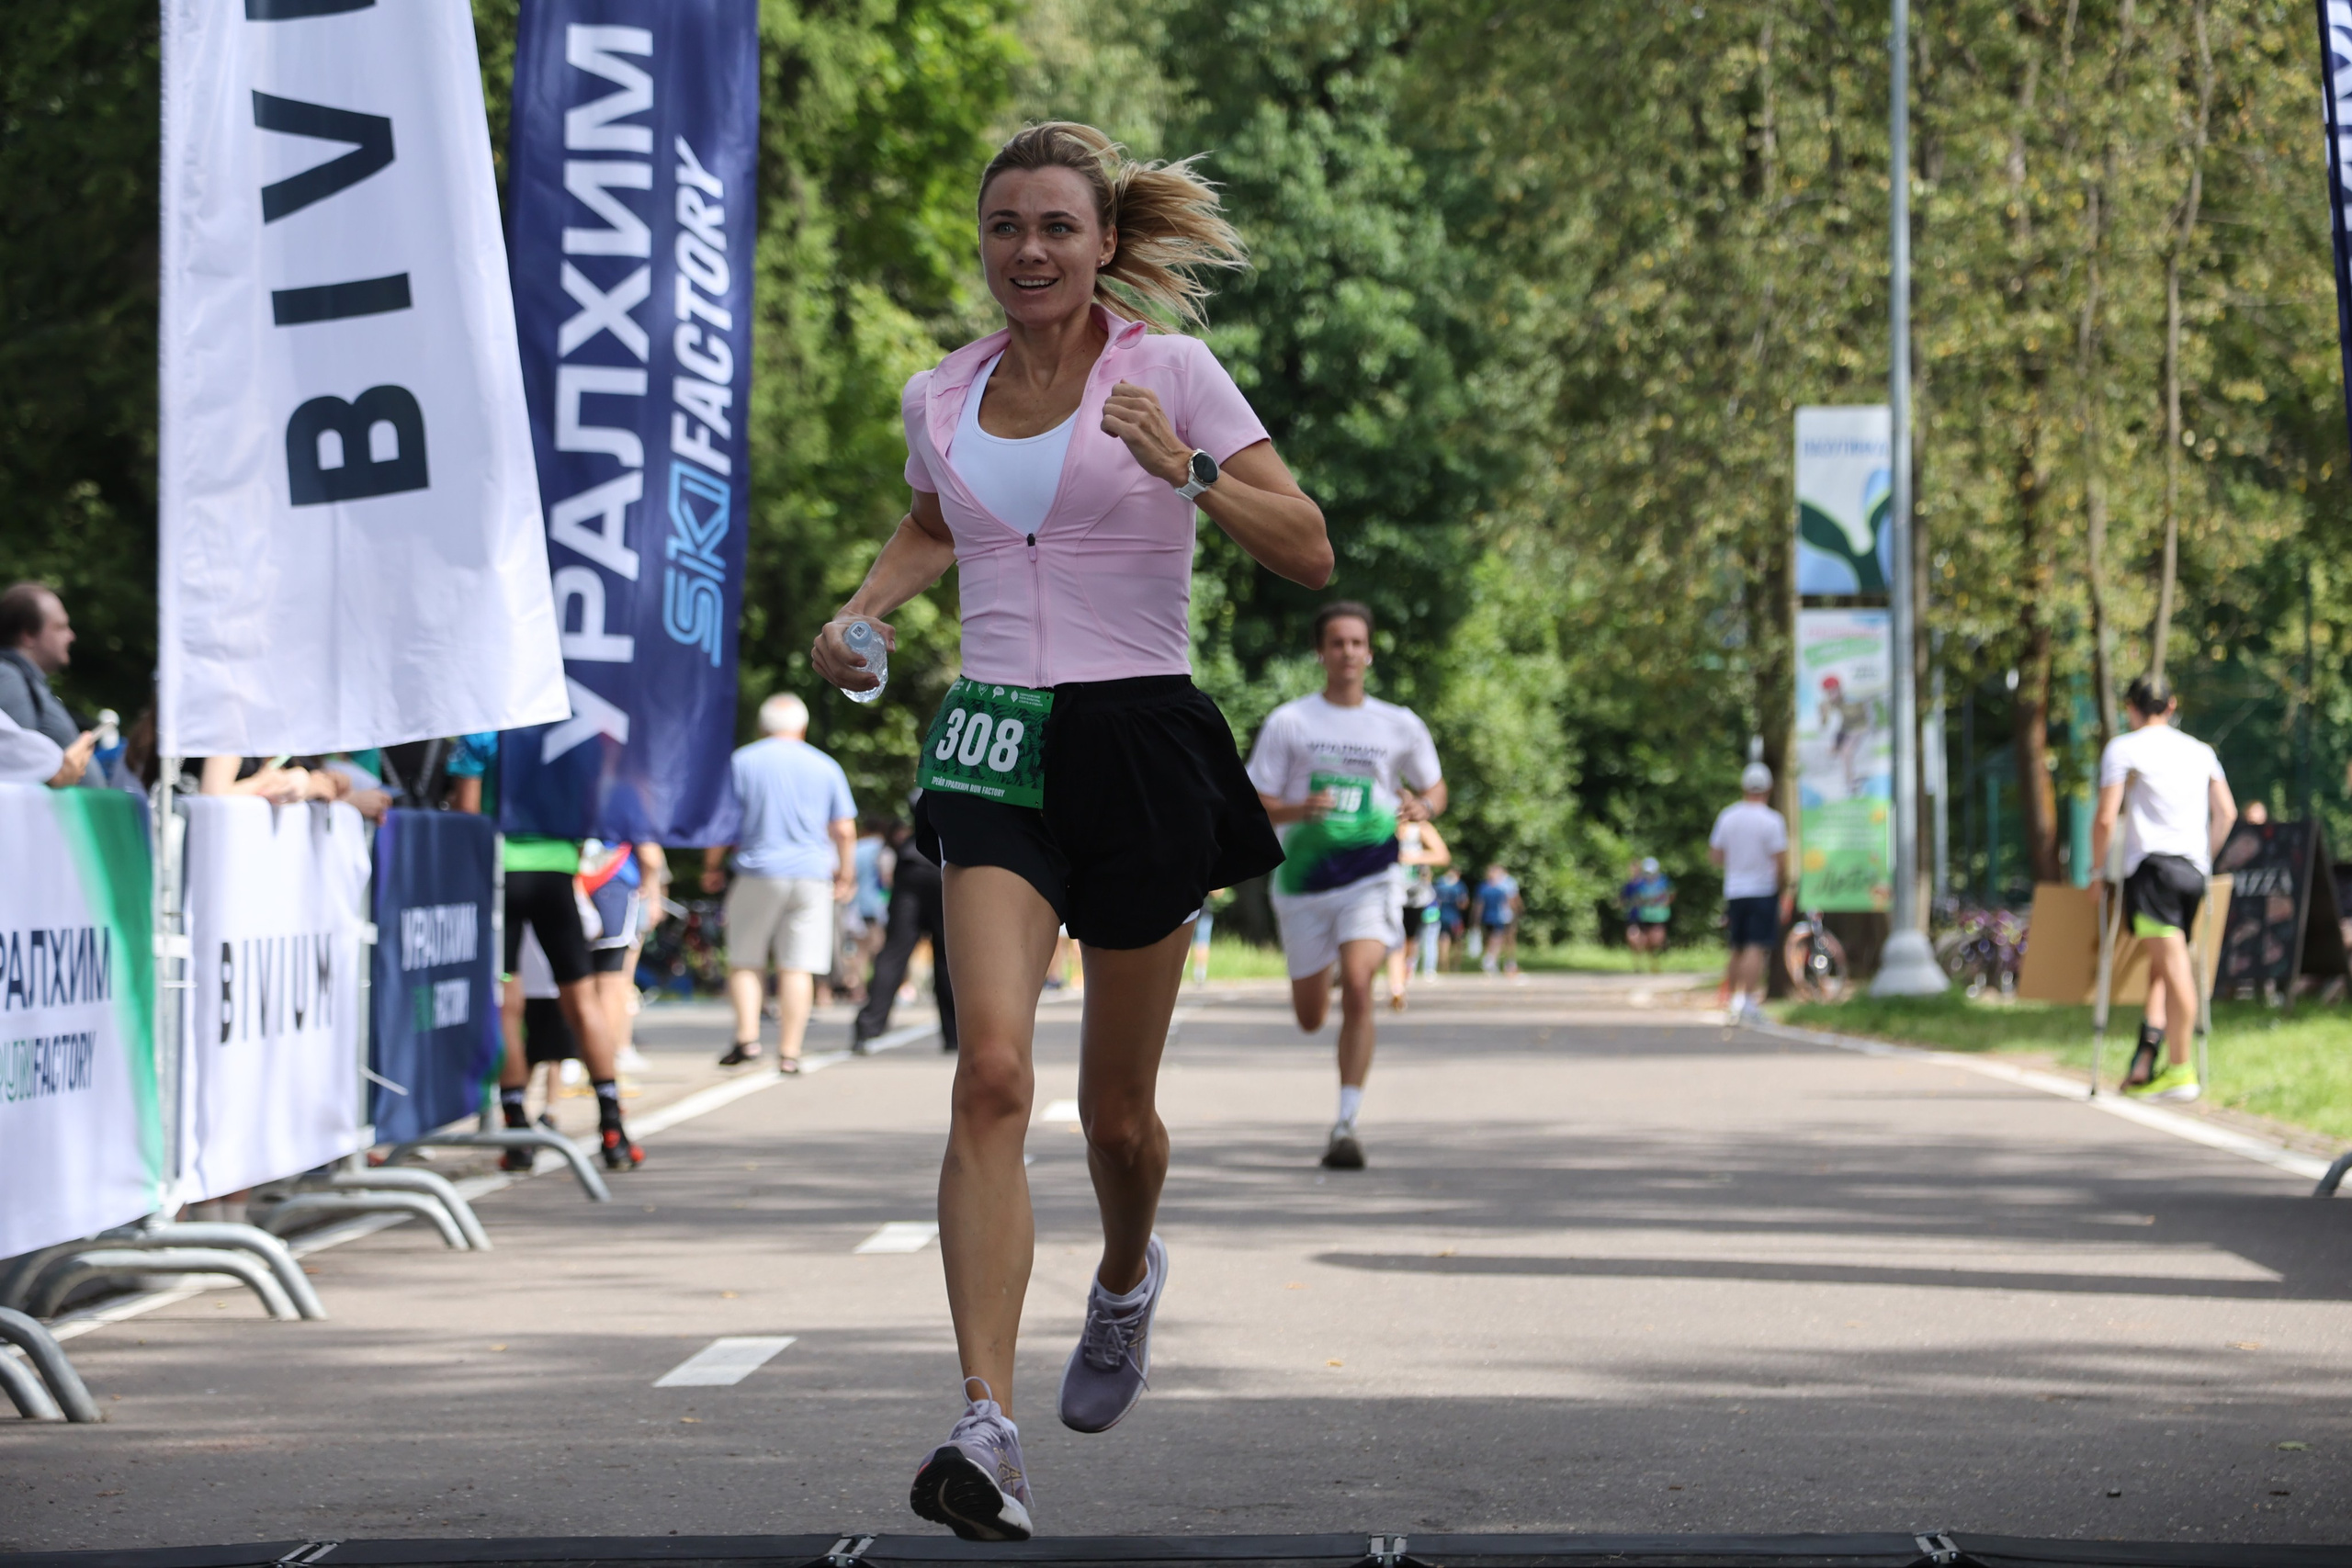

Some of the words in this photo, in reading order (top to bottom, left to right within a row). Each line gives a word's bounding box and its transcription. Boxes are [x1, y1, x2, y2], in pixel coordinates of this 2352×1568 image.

[245, 0, 430, 507] BIV
[671, 134, 734, 477] FACTORY
[540, 23, 654, 765] УРАЛХИМ
[662, 457, 731, 669] SKI
[935, 707, 1024, 773] 308
[969, 784, 982, 794] RUN
[981, 786, 1006, 797] FACTORY
[33, 1030, 96, 1100] FACTORY
[220, 931, 334, 1045] BIVIUM
